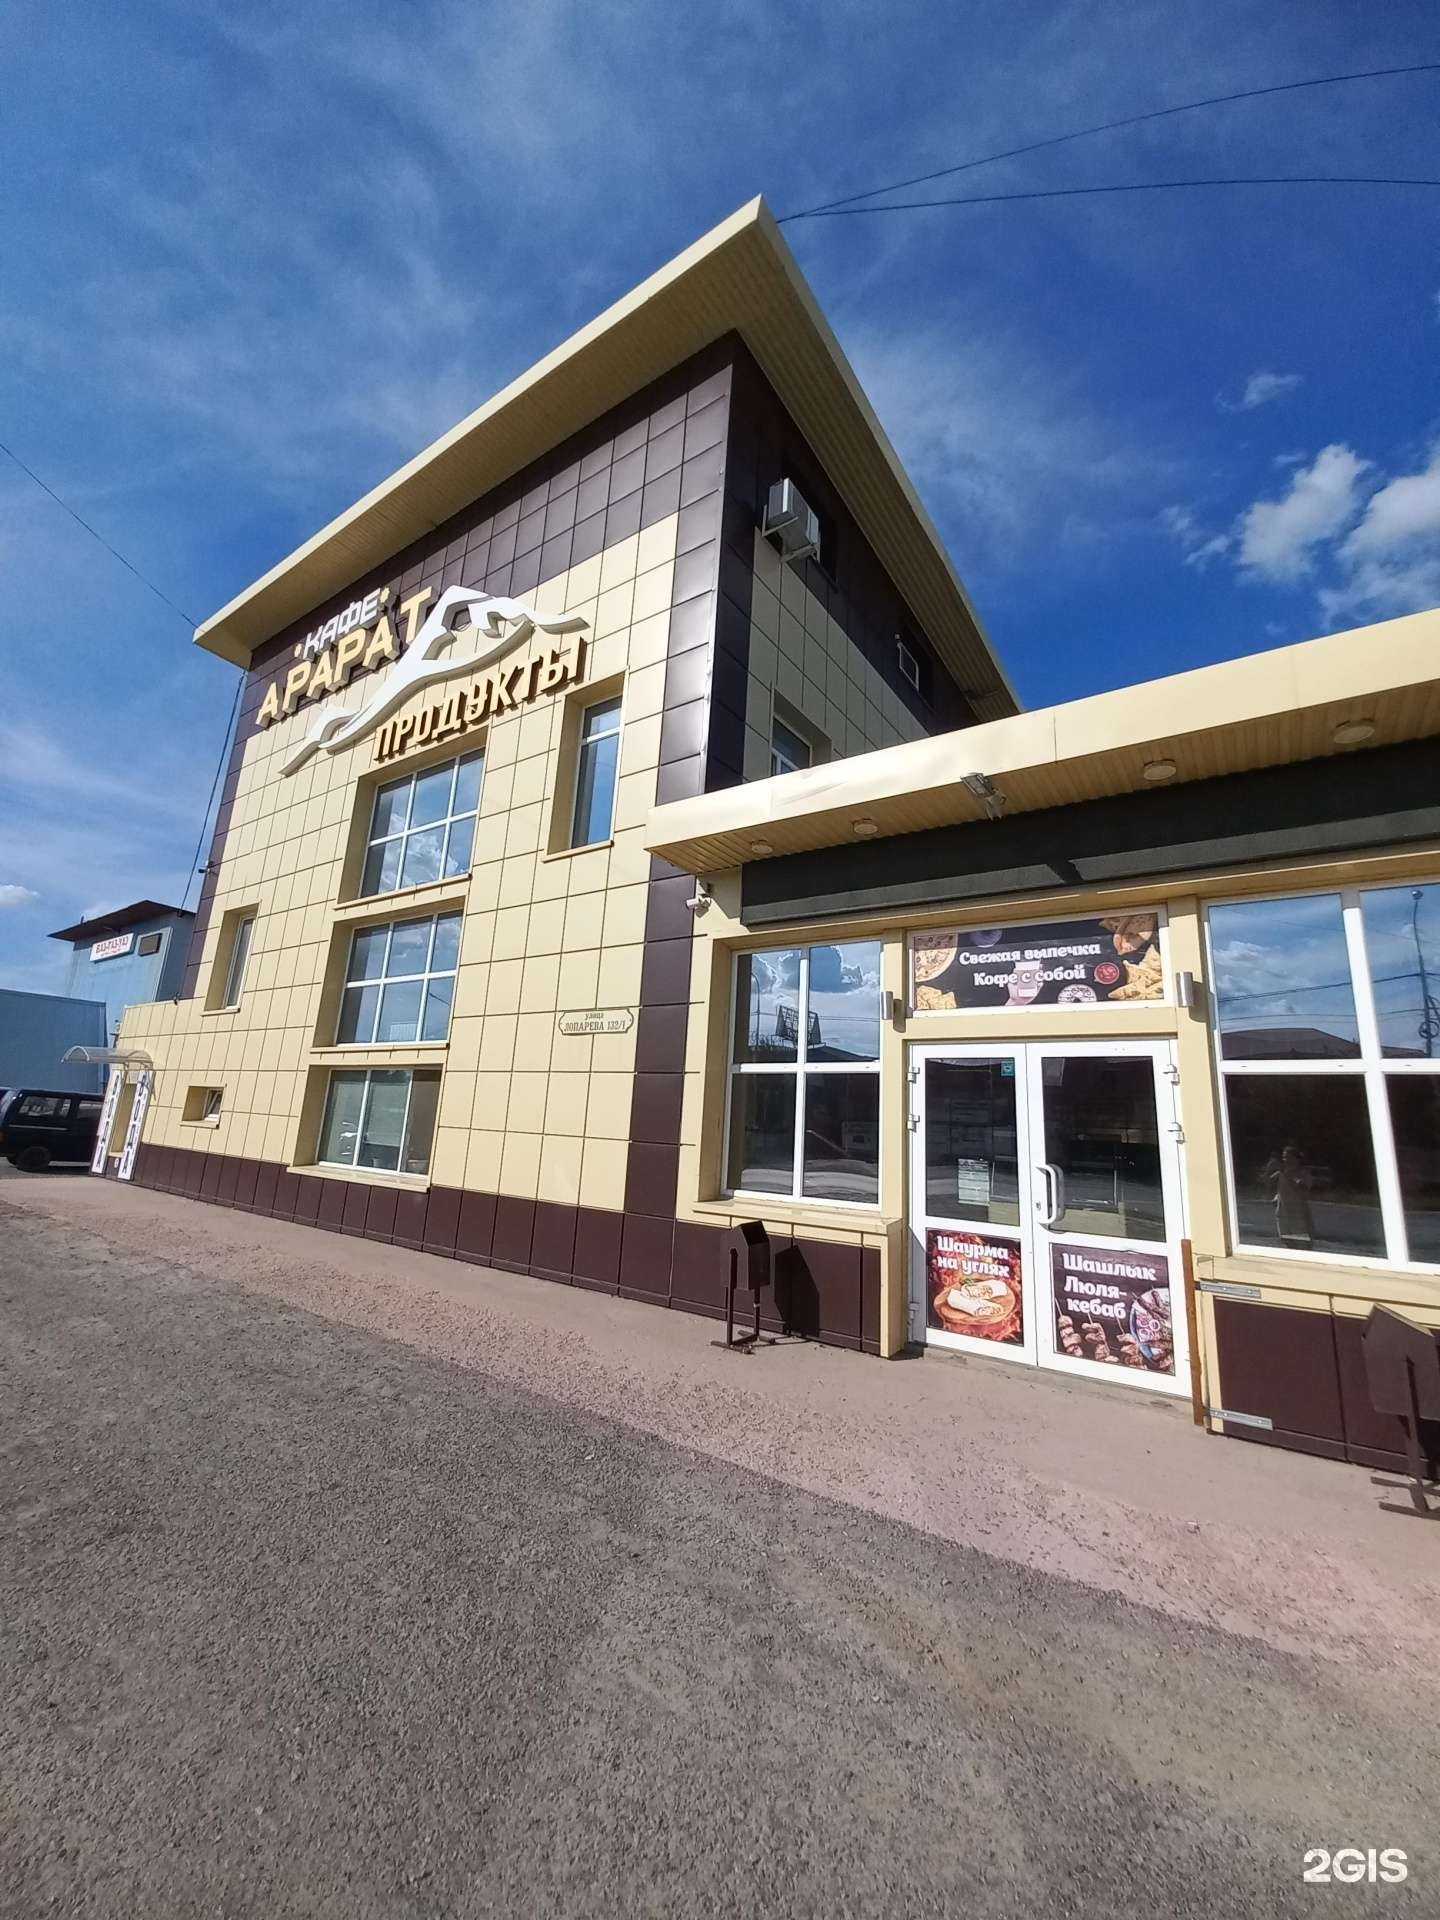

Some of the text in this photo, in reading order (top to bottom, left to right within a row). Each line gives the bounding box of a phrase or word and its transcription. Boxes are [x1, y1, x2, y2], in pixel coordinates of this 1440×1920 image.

[303, 588, 381, 662] КАФЕ
[255, 586, 433, 728] АРАРАТ
[375, 637, 587, 761] ПРОДУКТЫ
[959, 942, 1101, 966] Свежая выпечка
[973, 964, 1086, 987] Кофе с собой
[937, 1235, 1009, 1260] Шаурма
[937, 1255, 1010, 1277] на углях
[1062, 1253, 1157, 1281] Шашлык
[1064, 1276, 1128, 1297] Люля-
[1067, 1298, 1127, 1319] кебаб
